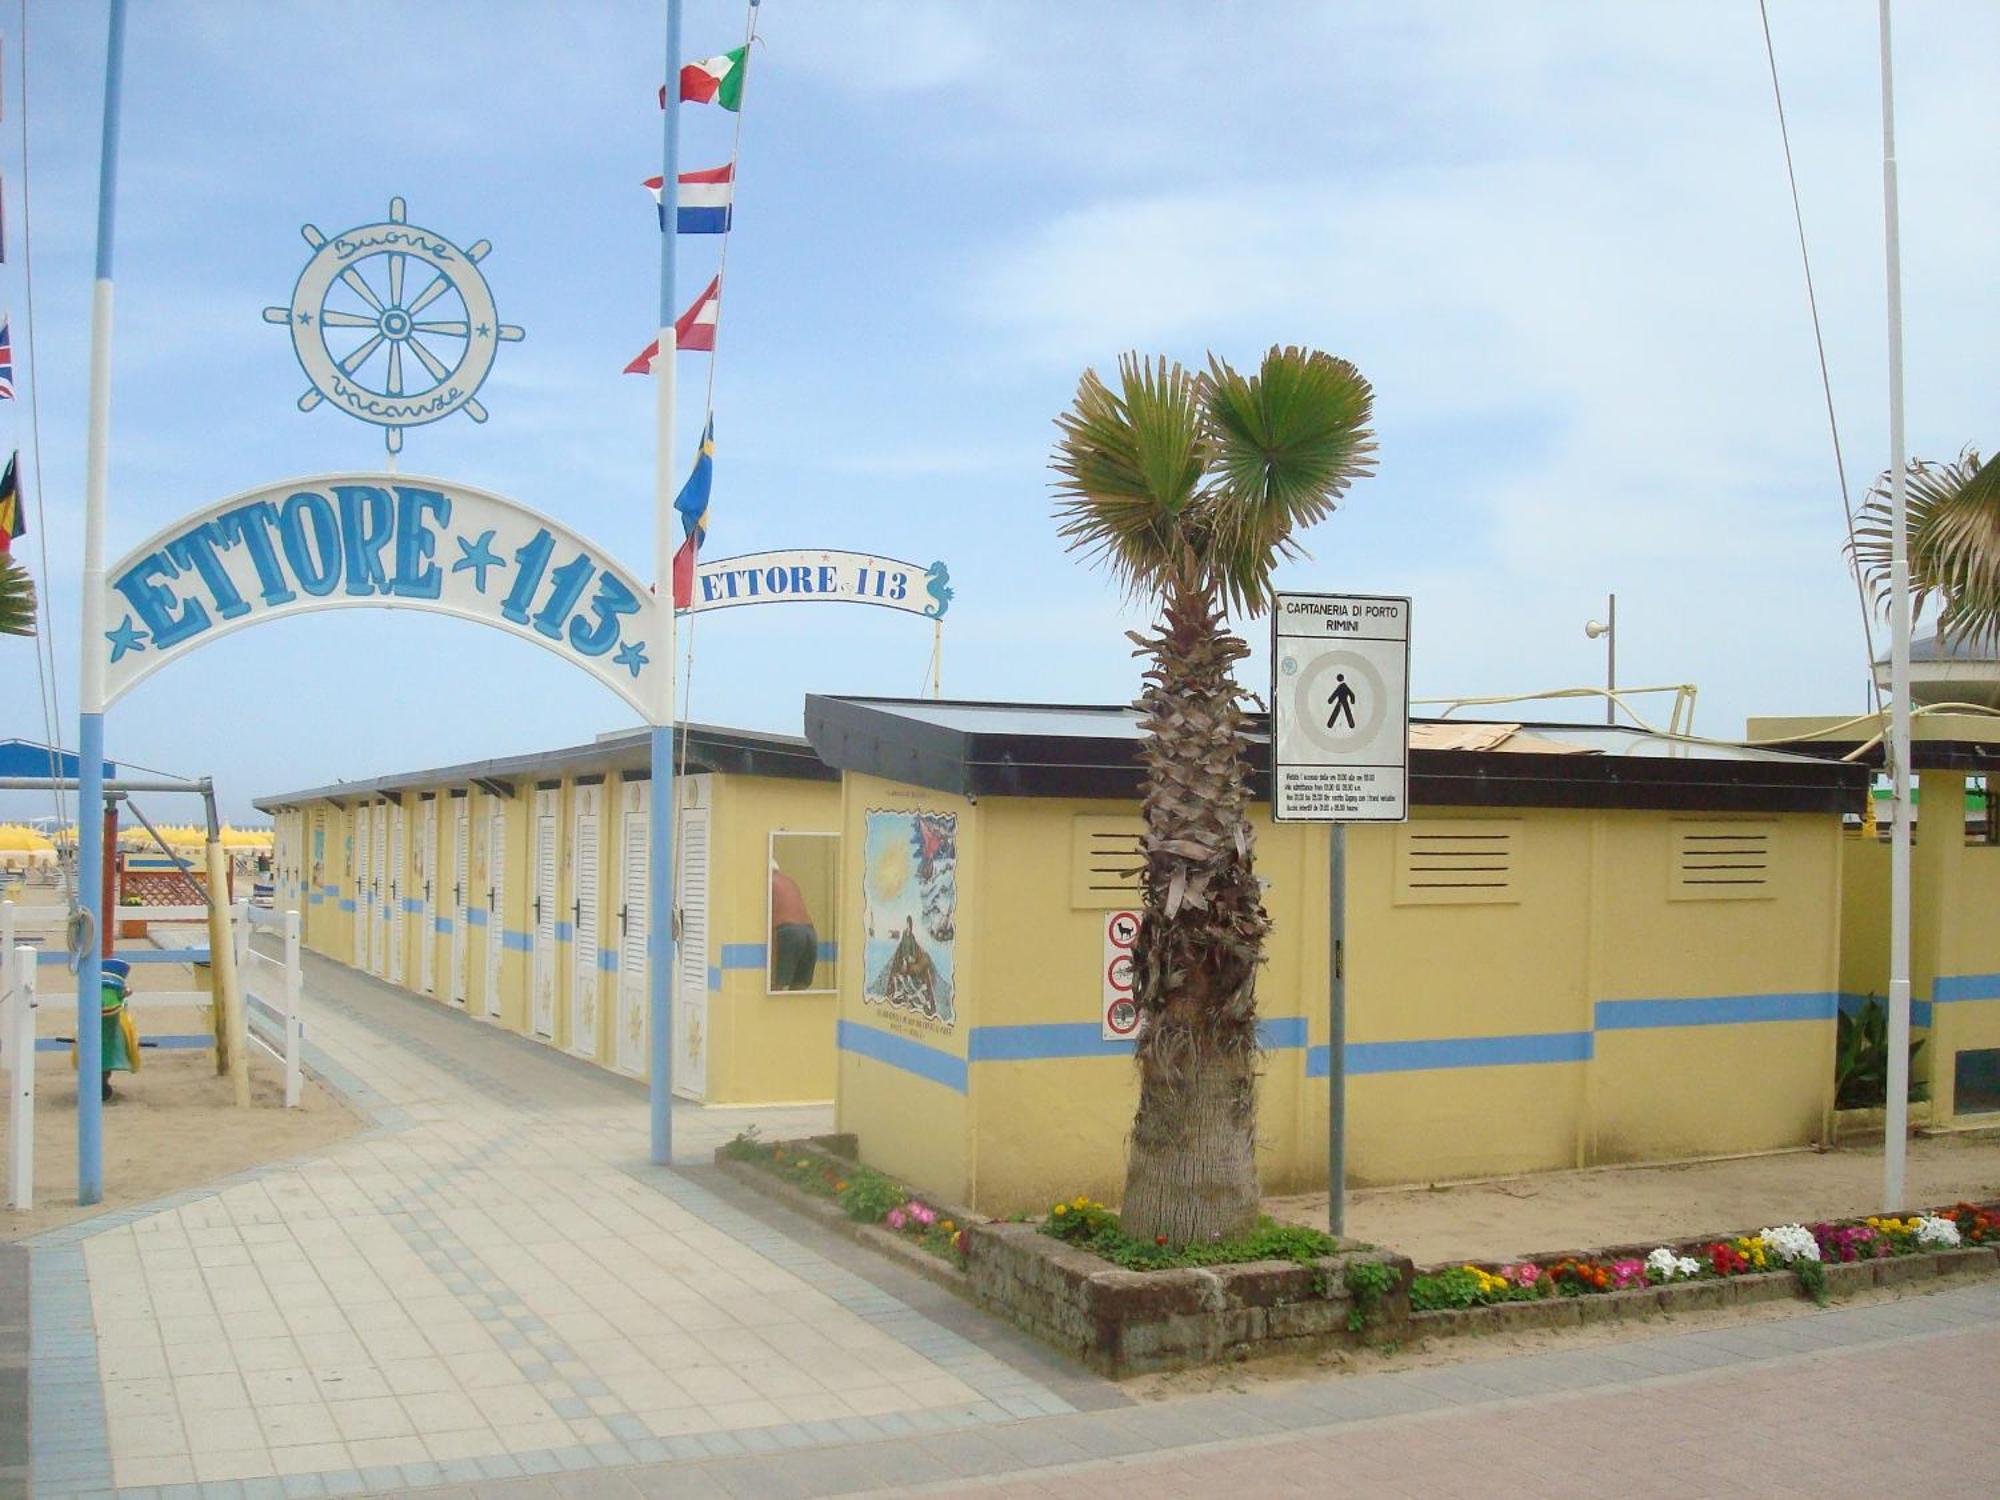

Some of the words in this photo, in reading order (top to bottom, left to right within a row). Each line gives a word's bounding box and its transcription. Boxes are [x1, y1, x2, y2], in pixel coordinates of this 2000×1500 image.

[335, 232, 456, 262] Buone
[113, 484, 452, 650] ETTORE
[501, 527, 642, 657] 113
[699, 565, 838, 602] ETTORE
[856, 568, 908, 600] 113
[1286, 602, 1349, 617] CAPITANERIA
[1352, 604, 1362, 617] DI
[1366, 606, 1398, 618] PORTO
[1326, 620, 1360, 632] RIMINI
